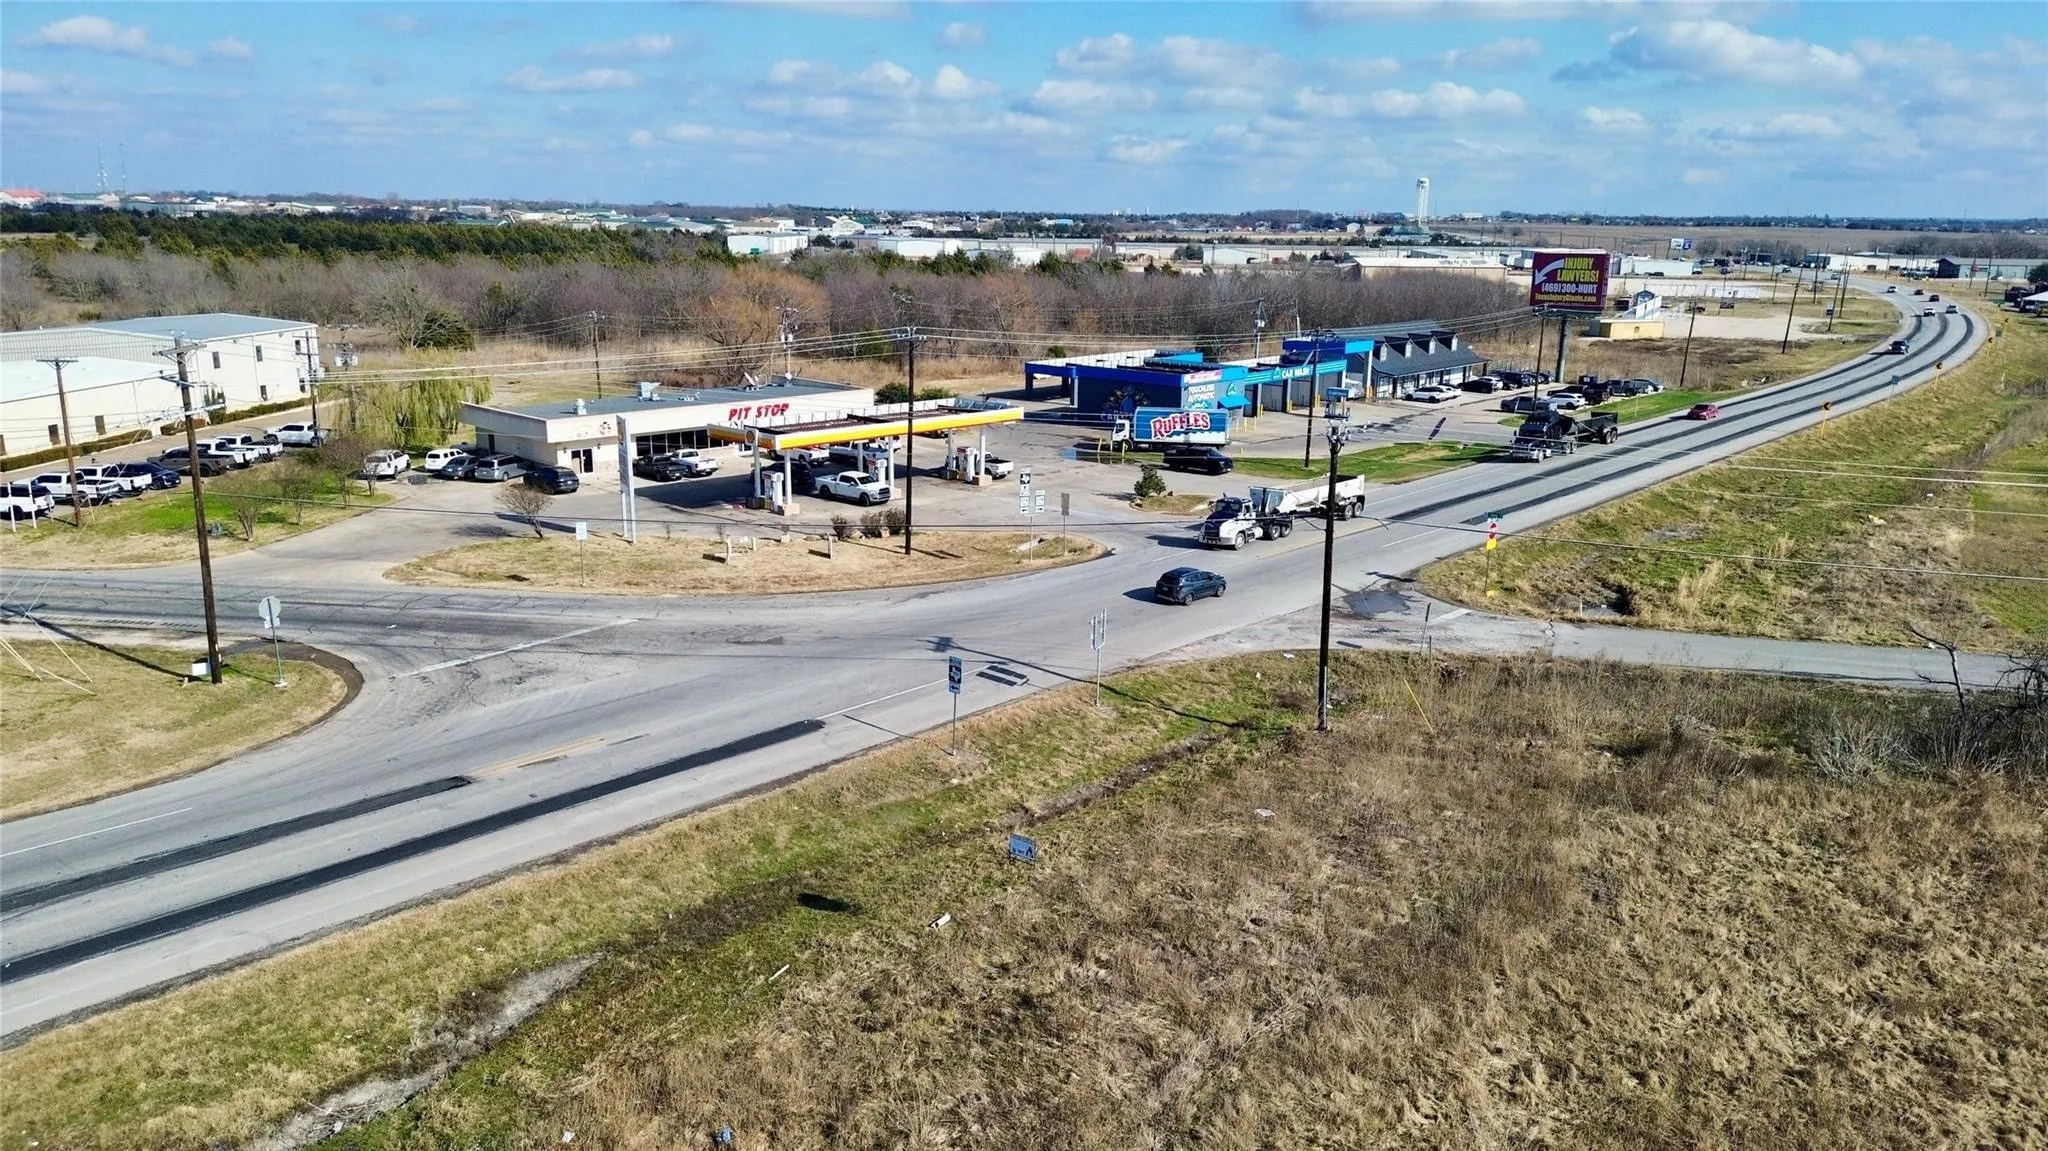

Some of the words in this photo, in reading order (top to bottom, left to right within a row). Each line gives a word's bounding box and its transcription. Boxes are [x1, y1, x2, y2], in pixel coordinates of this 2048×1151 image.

[1564, 257, 1594, 270] INJURY
[1557, 269, 1599, 282] LAWYERS!
[1281, 369, 1293, 379] CAR
[1295, 367, 1310, 377] WASH
[728, 408, 752, 421] PIT
[755, 403, 790, 418] STOP
[1151, 412, 1210, 439] RUFFLES
